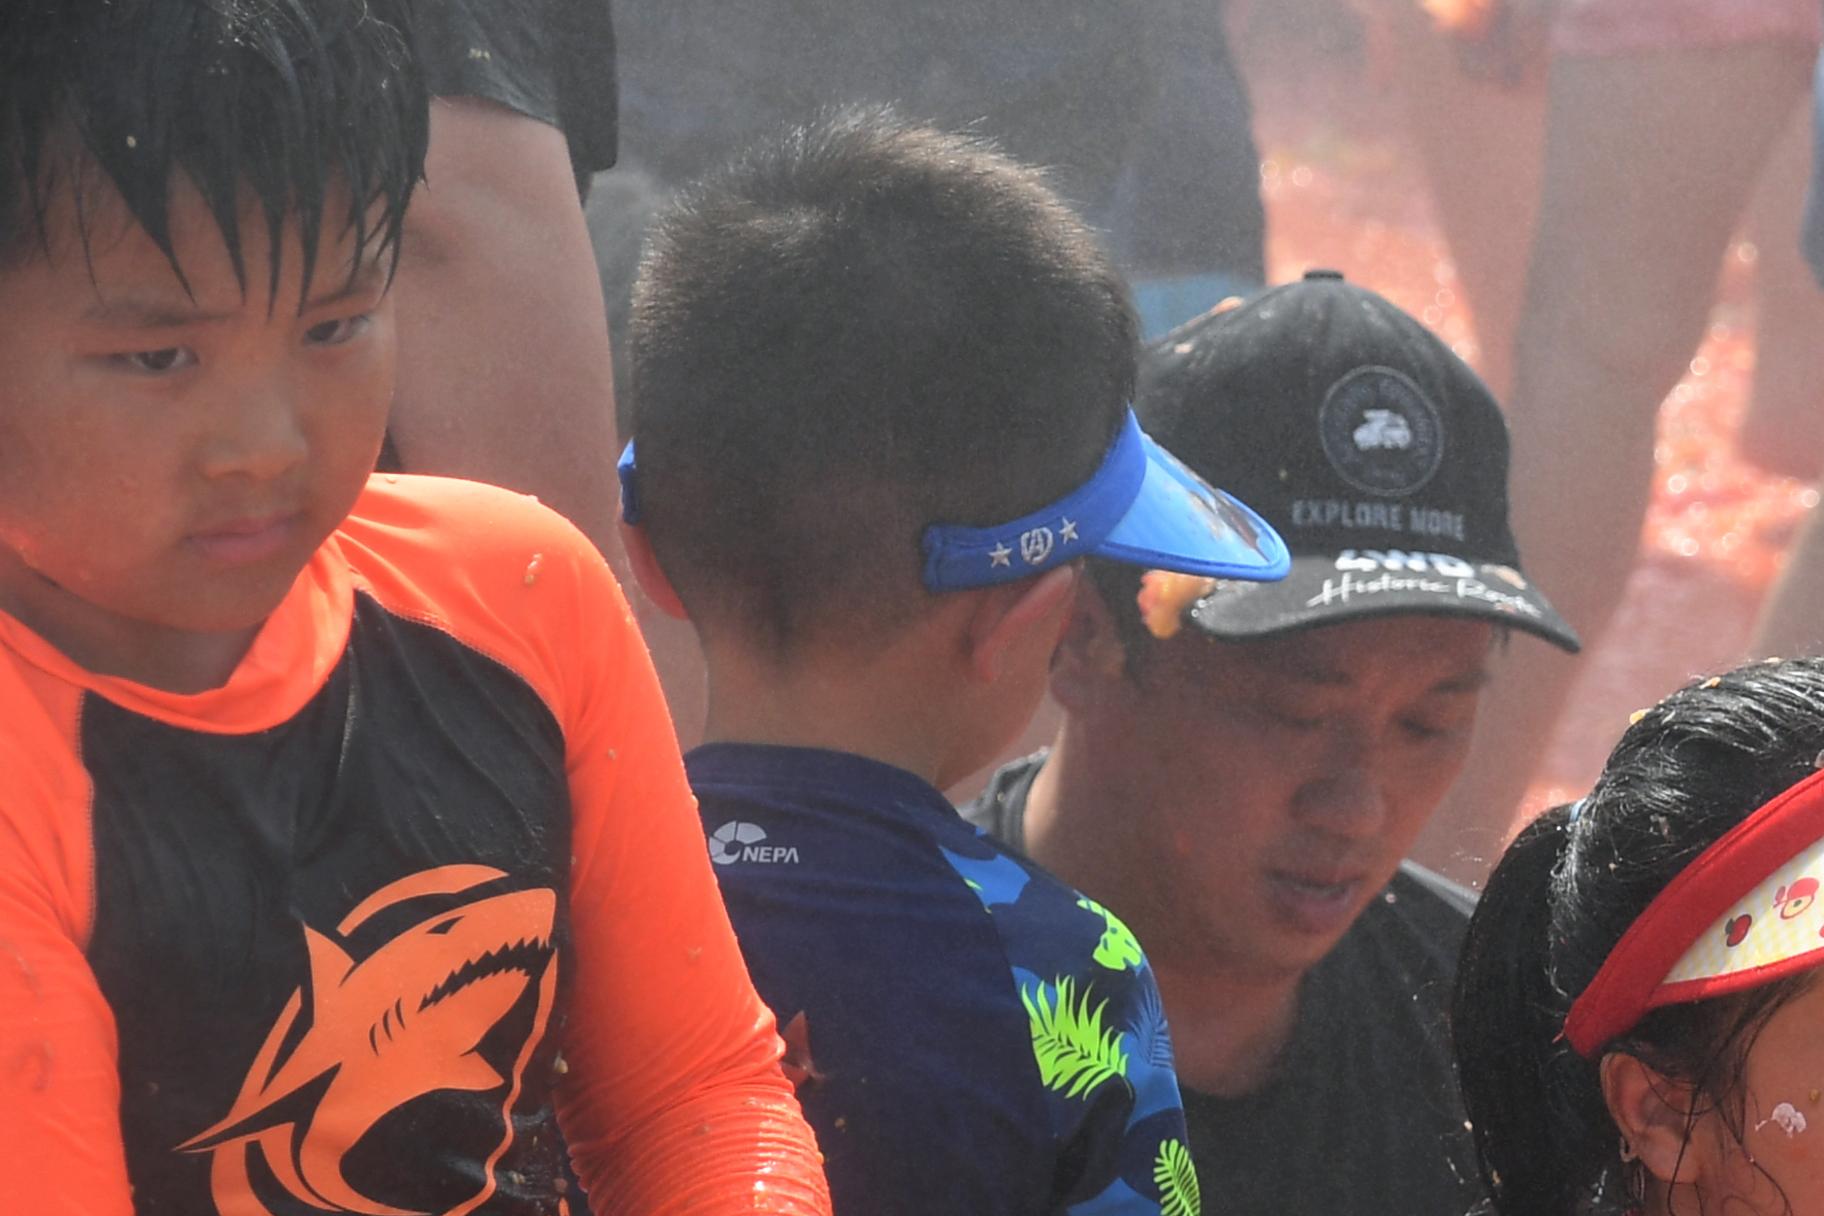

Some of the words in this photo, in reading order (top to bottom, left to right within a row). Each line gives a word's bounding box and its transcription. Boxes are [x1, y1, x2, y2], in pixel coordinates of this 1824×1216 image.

[1292, 499, 1401, 531] EXPLORE
[1409, 508, 1464, 541] MORE
[742, 845, 799, 864] NEPA
